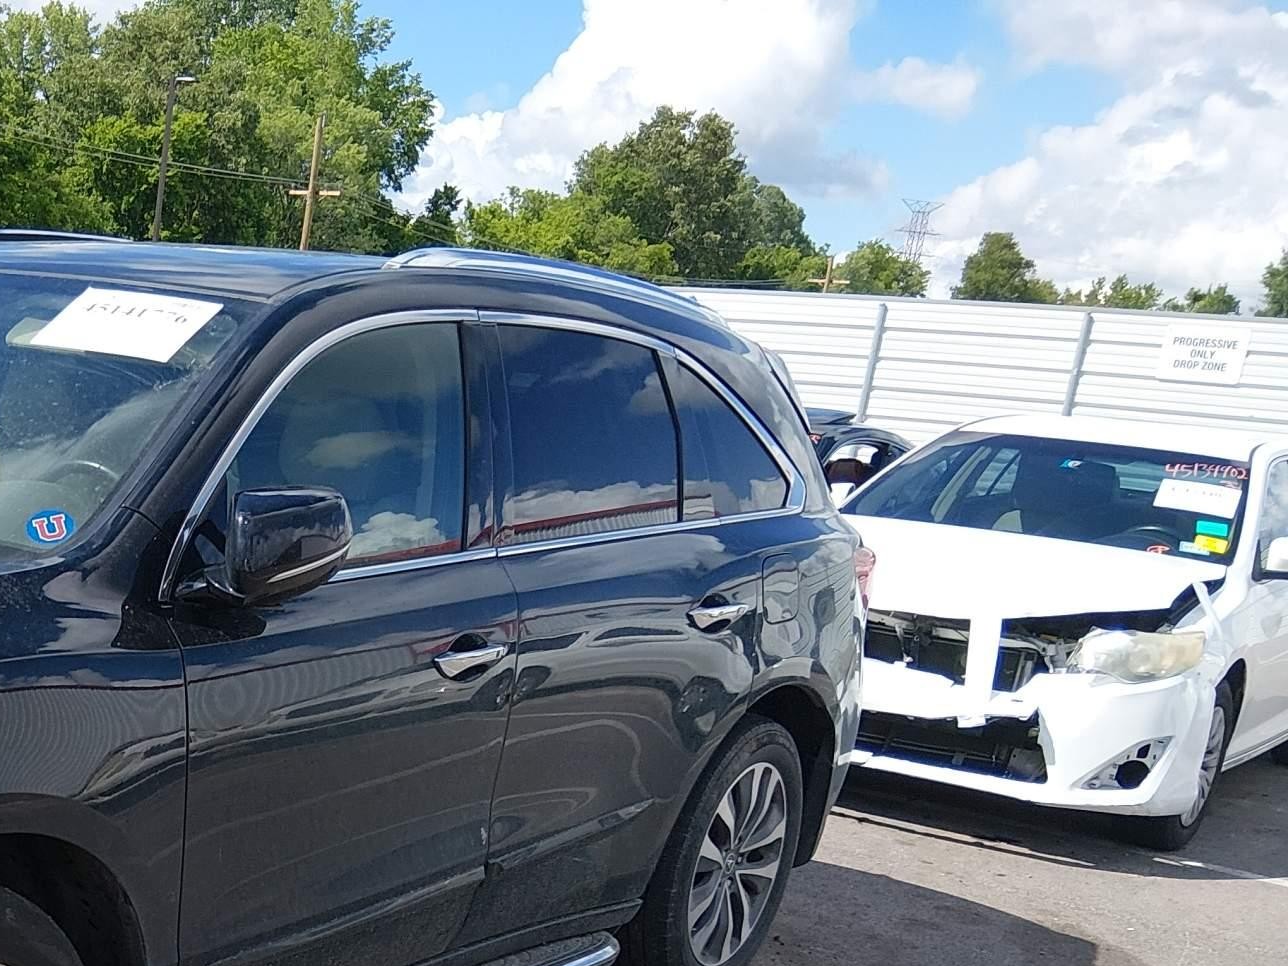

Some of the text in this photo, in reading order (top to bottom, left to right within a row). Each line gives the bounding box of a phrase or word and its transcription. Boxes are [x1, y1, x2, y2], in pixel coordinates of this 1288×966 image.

[1172, 336, 1240, 350] PROGRESSIVE
[1190, 349, 1216, 360] ONLY
[1172, 359, 1227, 372] DROP ZONE
[32, 513, 67, 542] U
